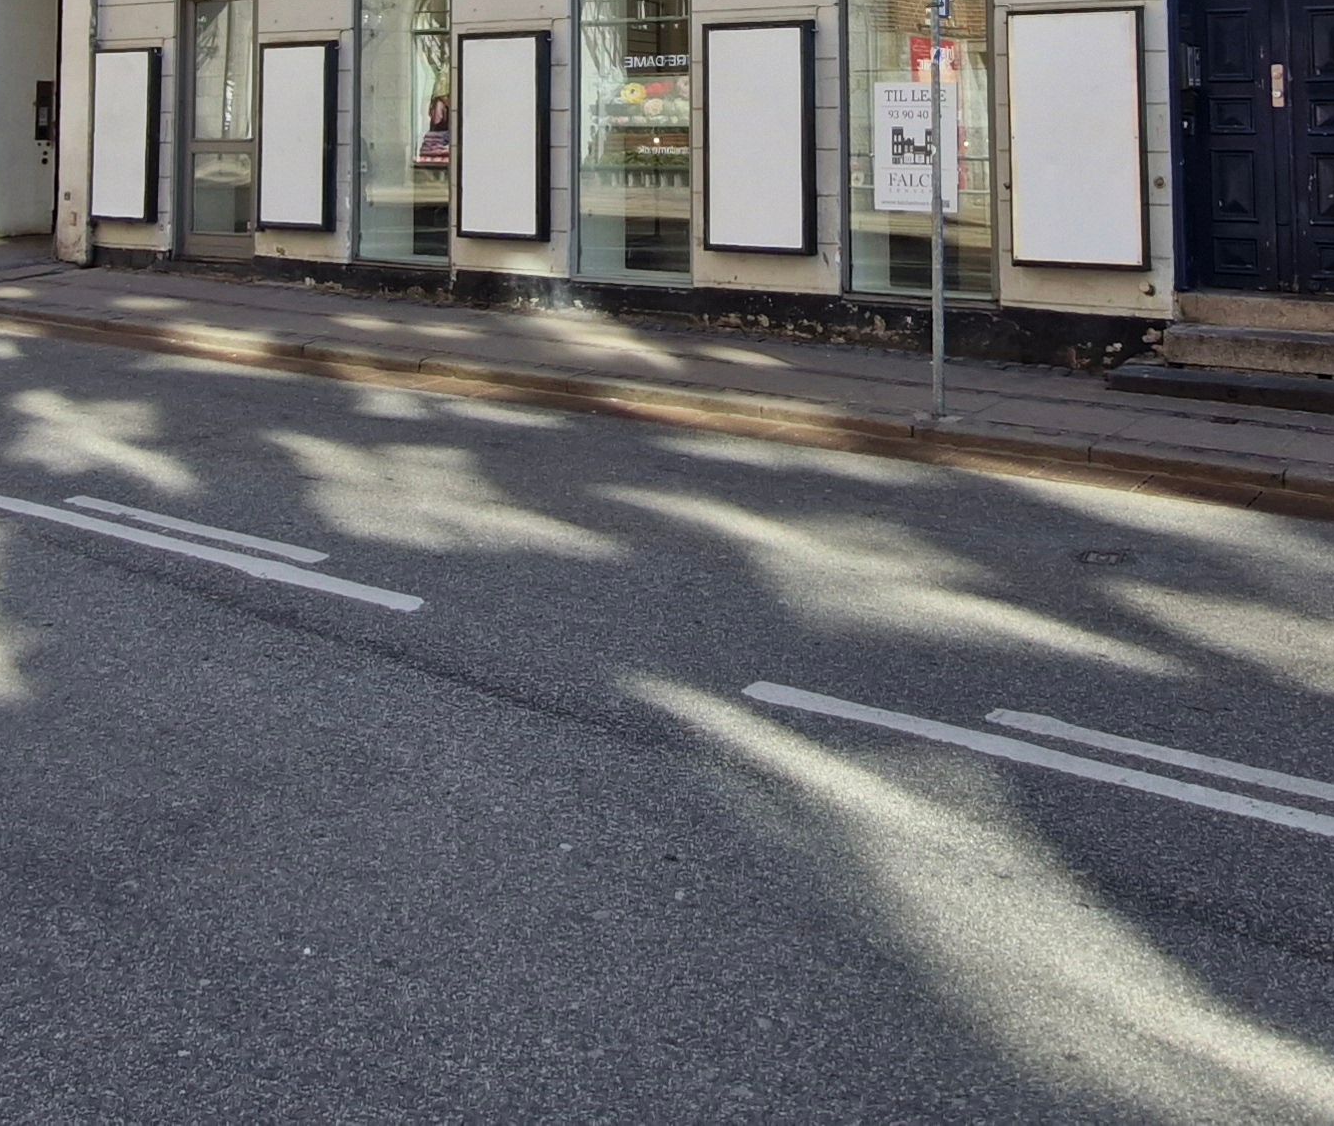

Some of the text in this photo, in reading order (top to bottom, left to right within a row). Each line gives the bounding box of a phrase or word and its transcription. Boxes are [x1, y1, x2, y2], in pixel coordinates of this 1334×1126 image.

[884, 89, 947, 102] TIL LEE
[888, 110, 929, 119] 93 90 40
[888, 172, 932, 187] FALC
